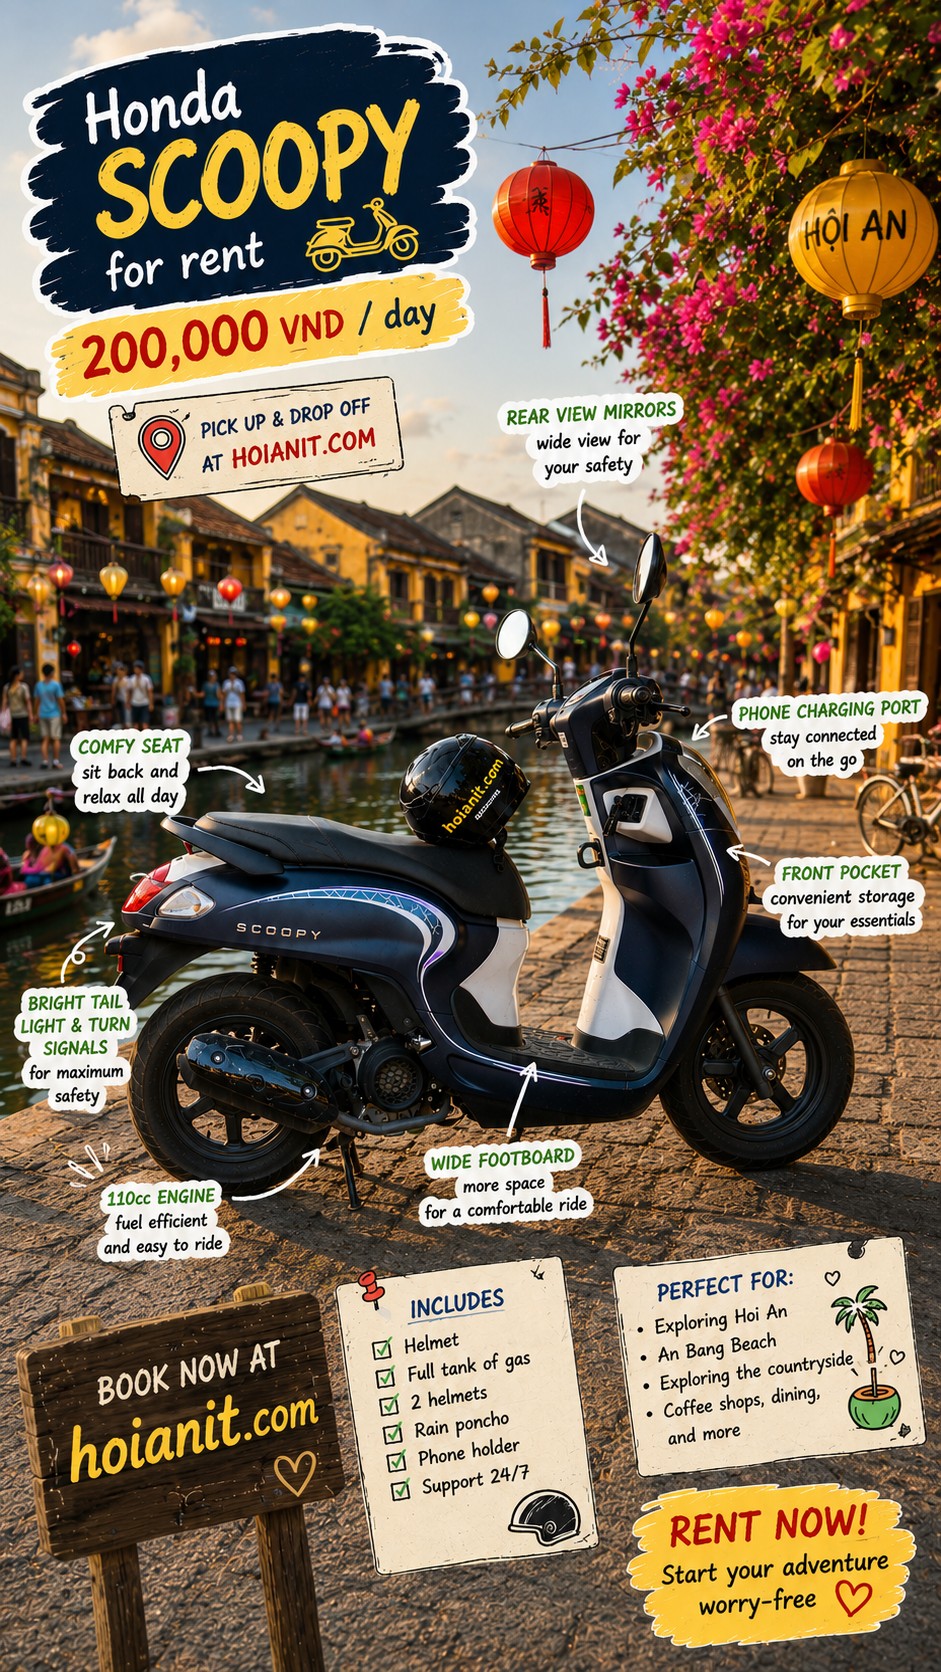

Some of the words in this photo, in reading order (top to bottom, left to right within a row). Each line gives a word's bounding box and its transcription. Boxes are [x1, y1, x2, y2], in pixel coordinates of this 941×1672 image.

[805, 208, 849, 252] HỘI
[861, 210, 907, 241] AN
[442, 760, 503, 833] hoianit.com
[237, 923, 320, 939] SCOOPY
[98, 1364, 169, 1405] BOOK
[181, 1348, 238, 1387] NOW
[250, 1340, 280, 1373] AT
[70, 1394, 319, 1484] hoianit.com
